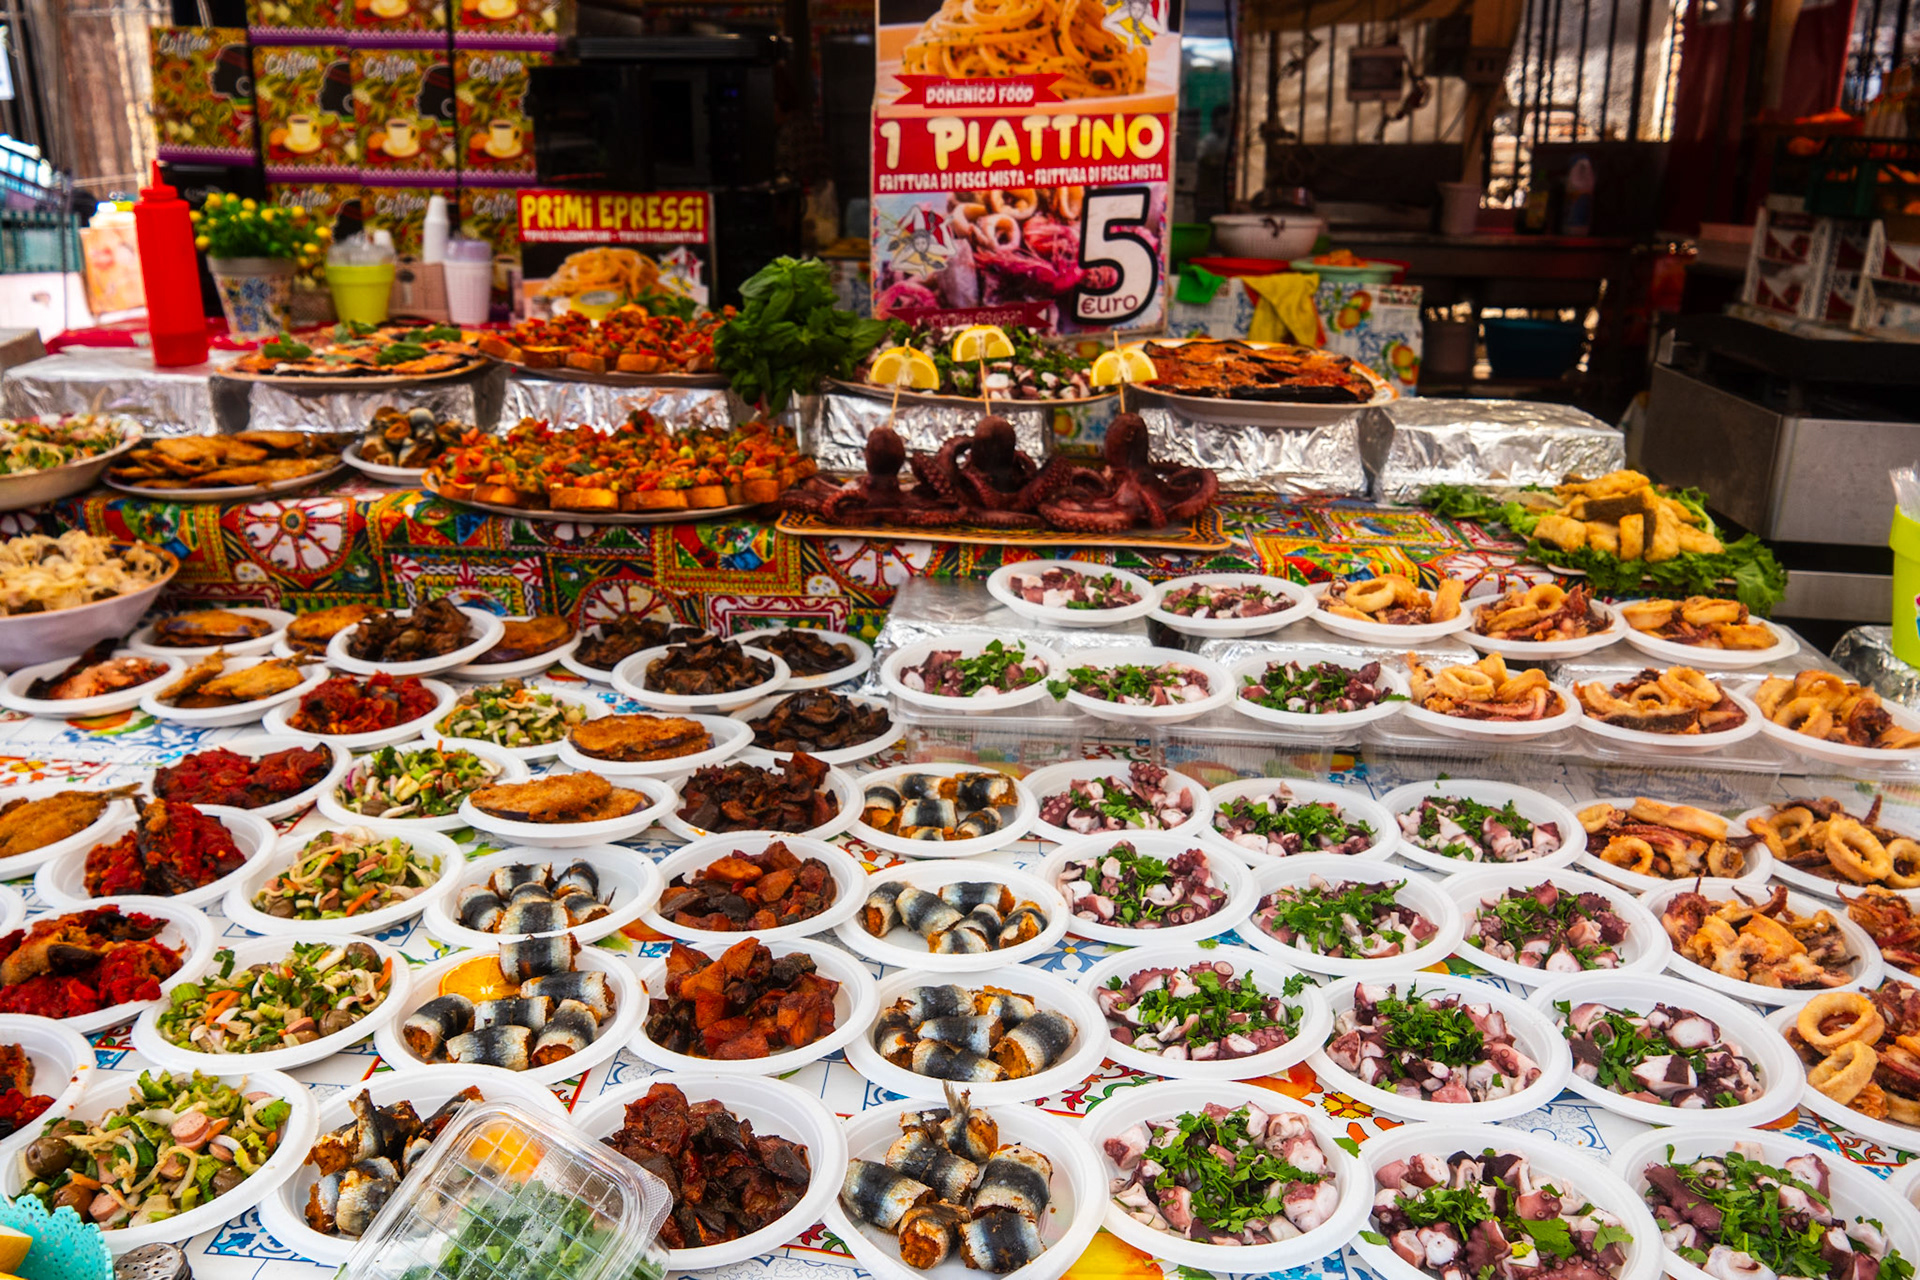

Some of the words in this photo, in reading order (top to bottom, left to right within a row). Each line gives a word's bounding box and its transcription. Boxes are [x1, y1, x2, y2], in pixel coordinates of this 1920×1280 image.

[926, 83, 996, 104] DOMENICO
[998, 83, 1034, 104] FOOD
[879, 120, 901, 169] 1
[927, 113, 1165, 171] PIATTINO
[879, 173, 939, 191] FRITTURA
[940, 172, 952, 189] DI
[954, 171, 987, 189] PESCE
[988, 169, 1026, 187] MISTA
[1034, 167, 1087, 185] FRITTURA
[1088, 166, 1100, 183] DI
[1101, 164, 1130, 182] PESCE
[1131, 163, 1163, 180] MISTA
[1071, 186, 1159, 327] 5
